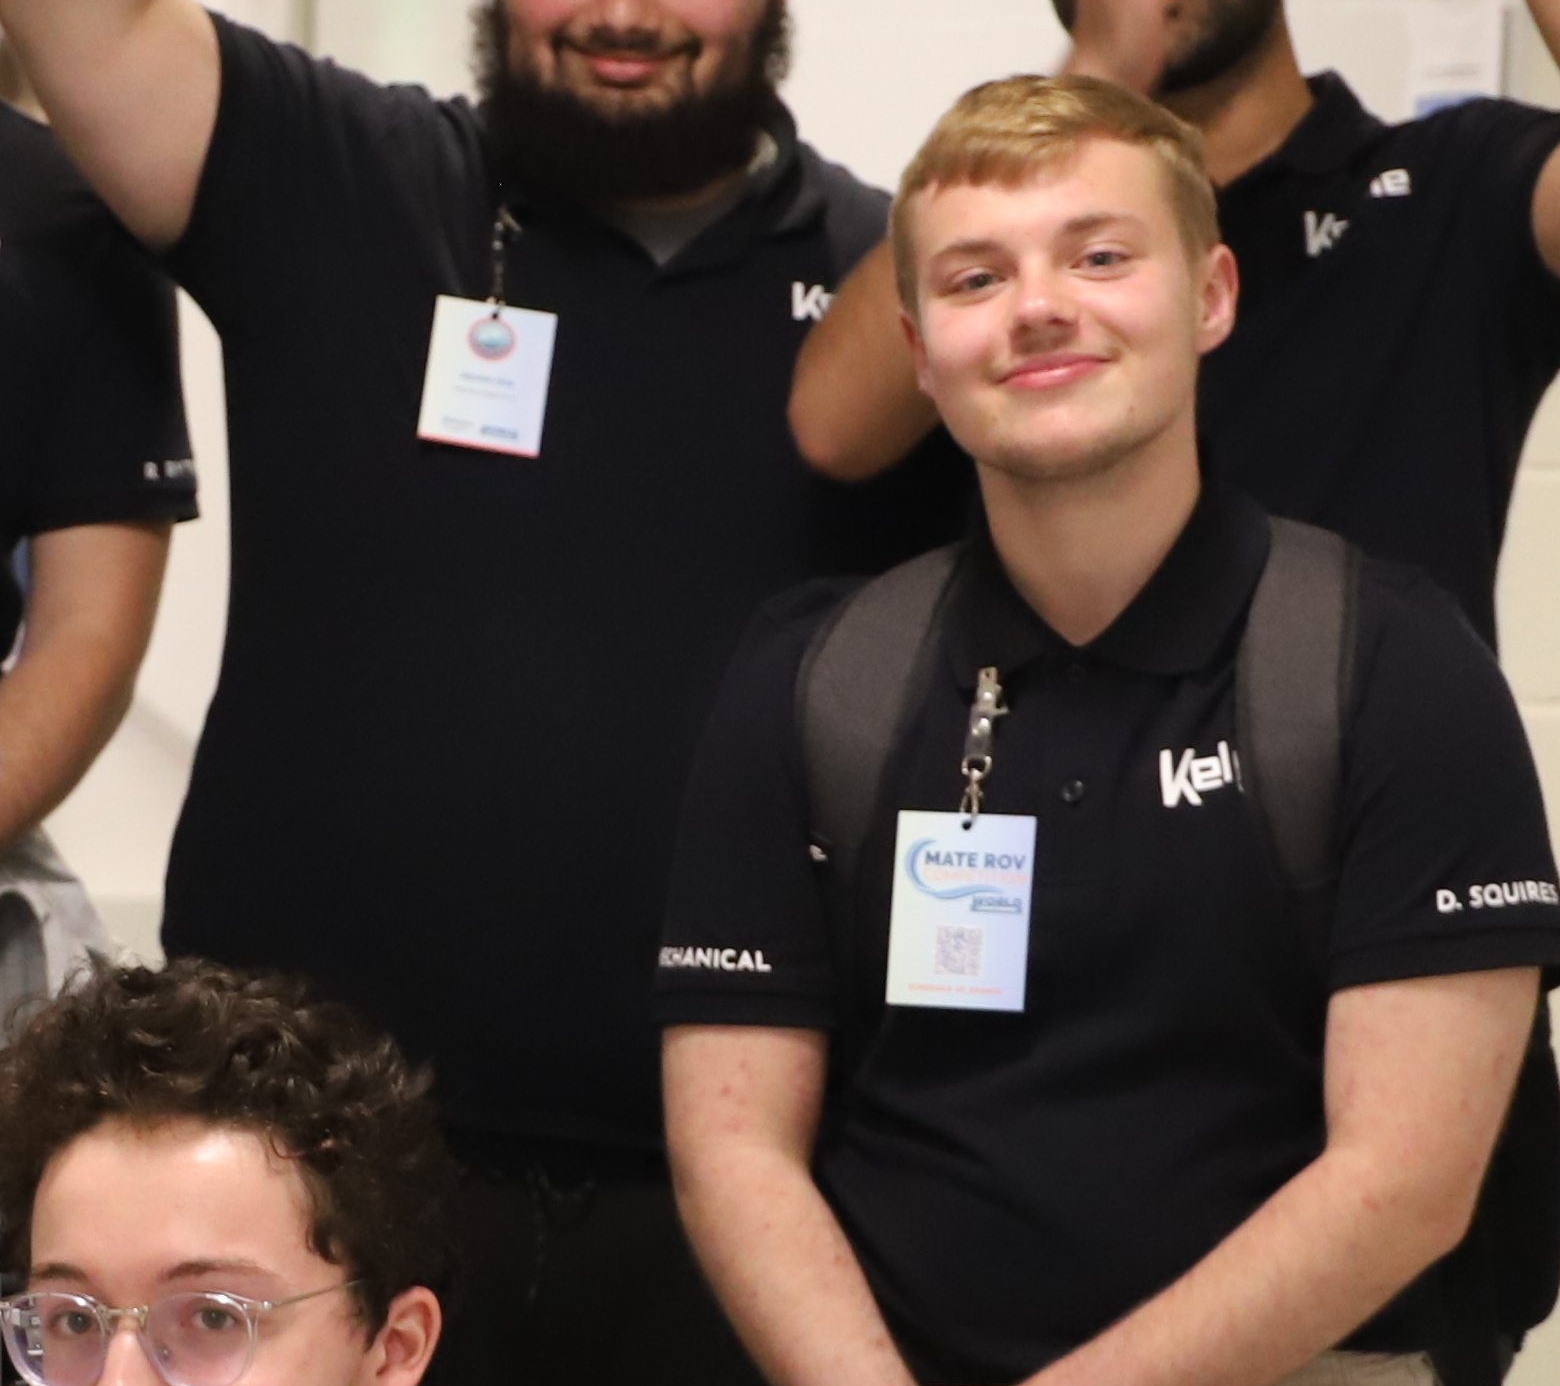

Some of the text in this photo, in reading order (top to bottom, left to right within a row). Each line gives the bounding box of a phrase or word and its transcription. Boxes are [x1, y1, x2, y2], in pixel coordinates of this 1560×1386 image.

[1159, 740, 1242, 808] Kel
[925, 850, 1026, 870] MATE ROV
[1436, 880, 1559, 913] D. SQUIRES
